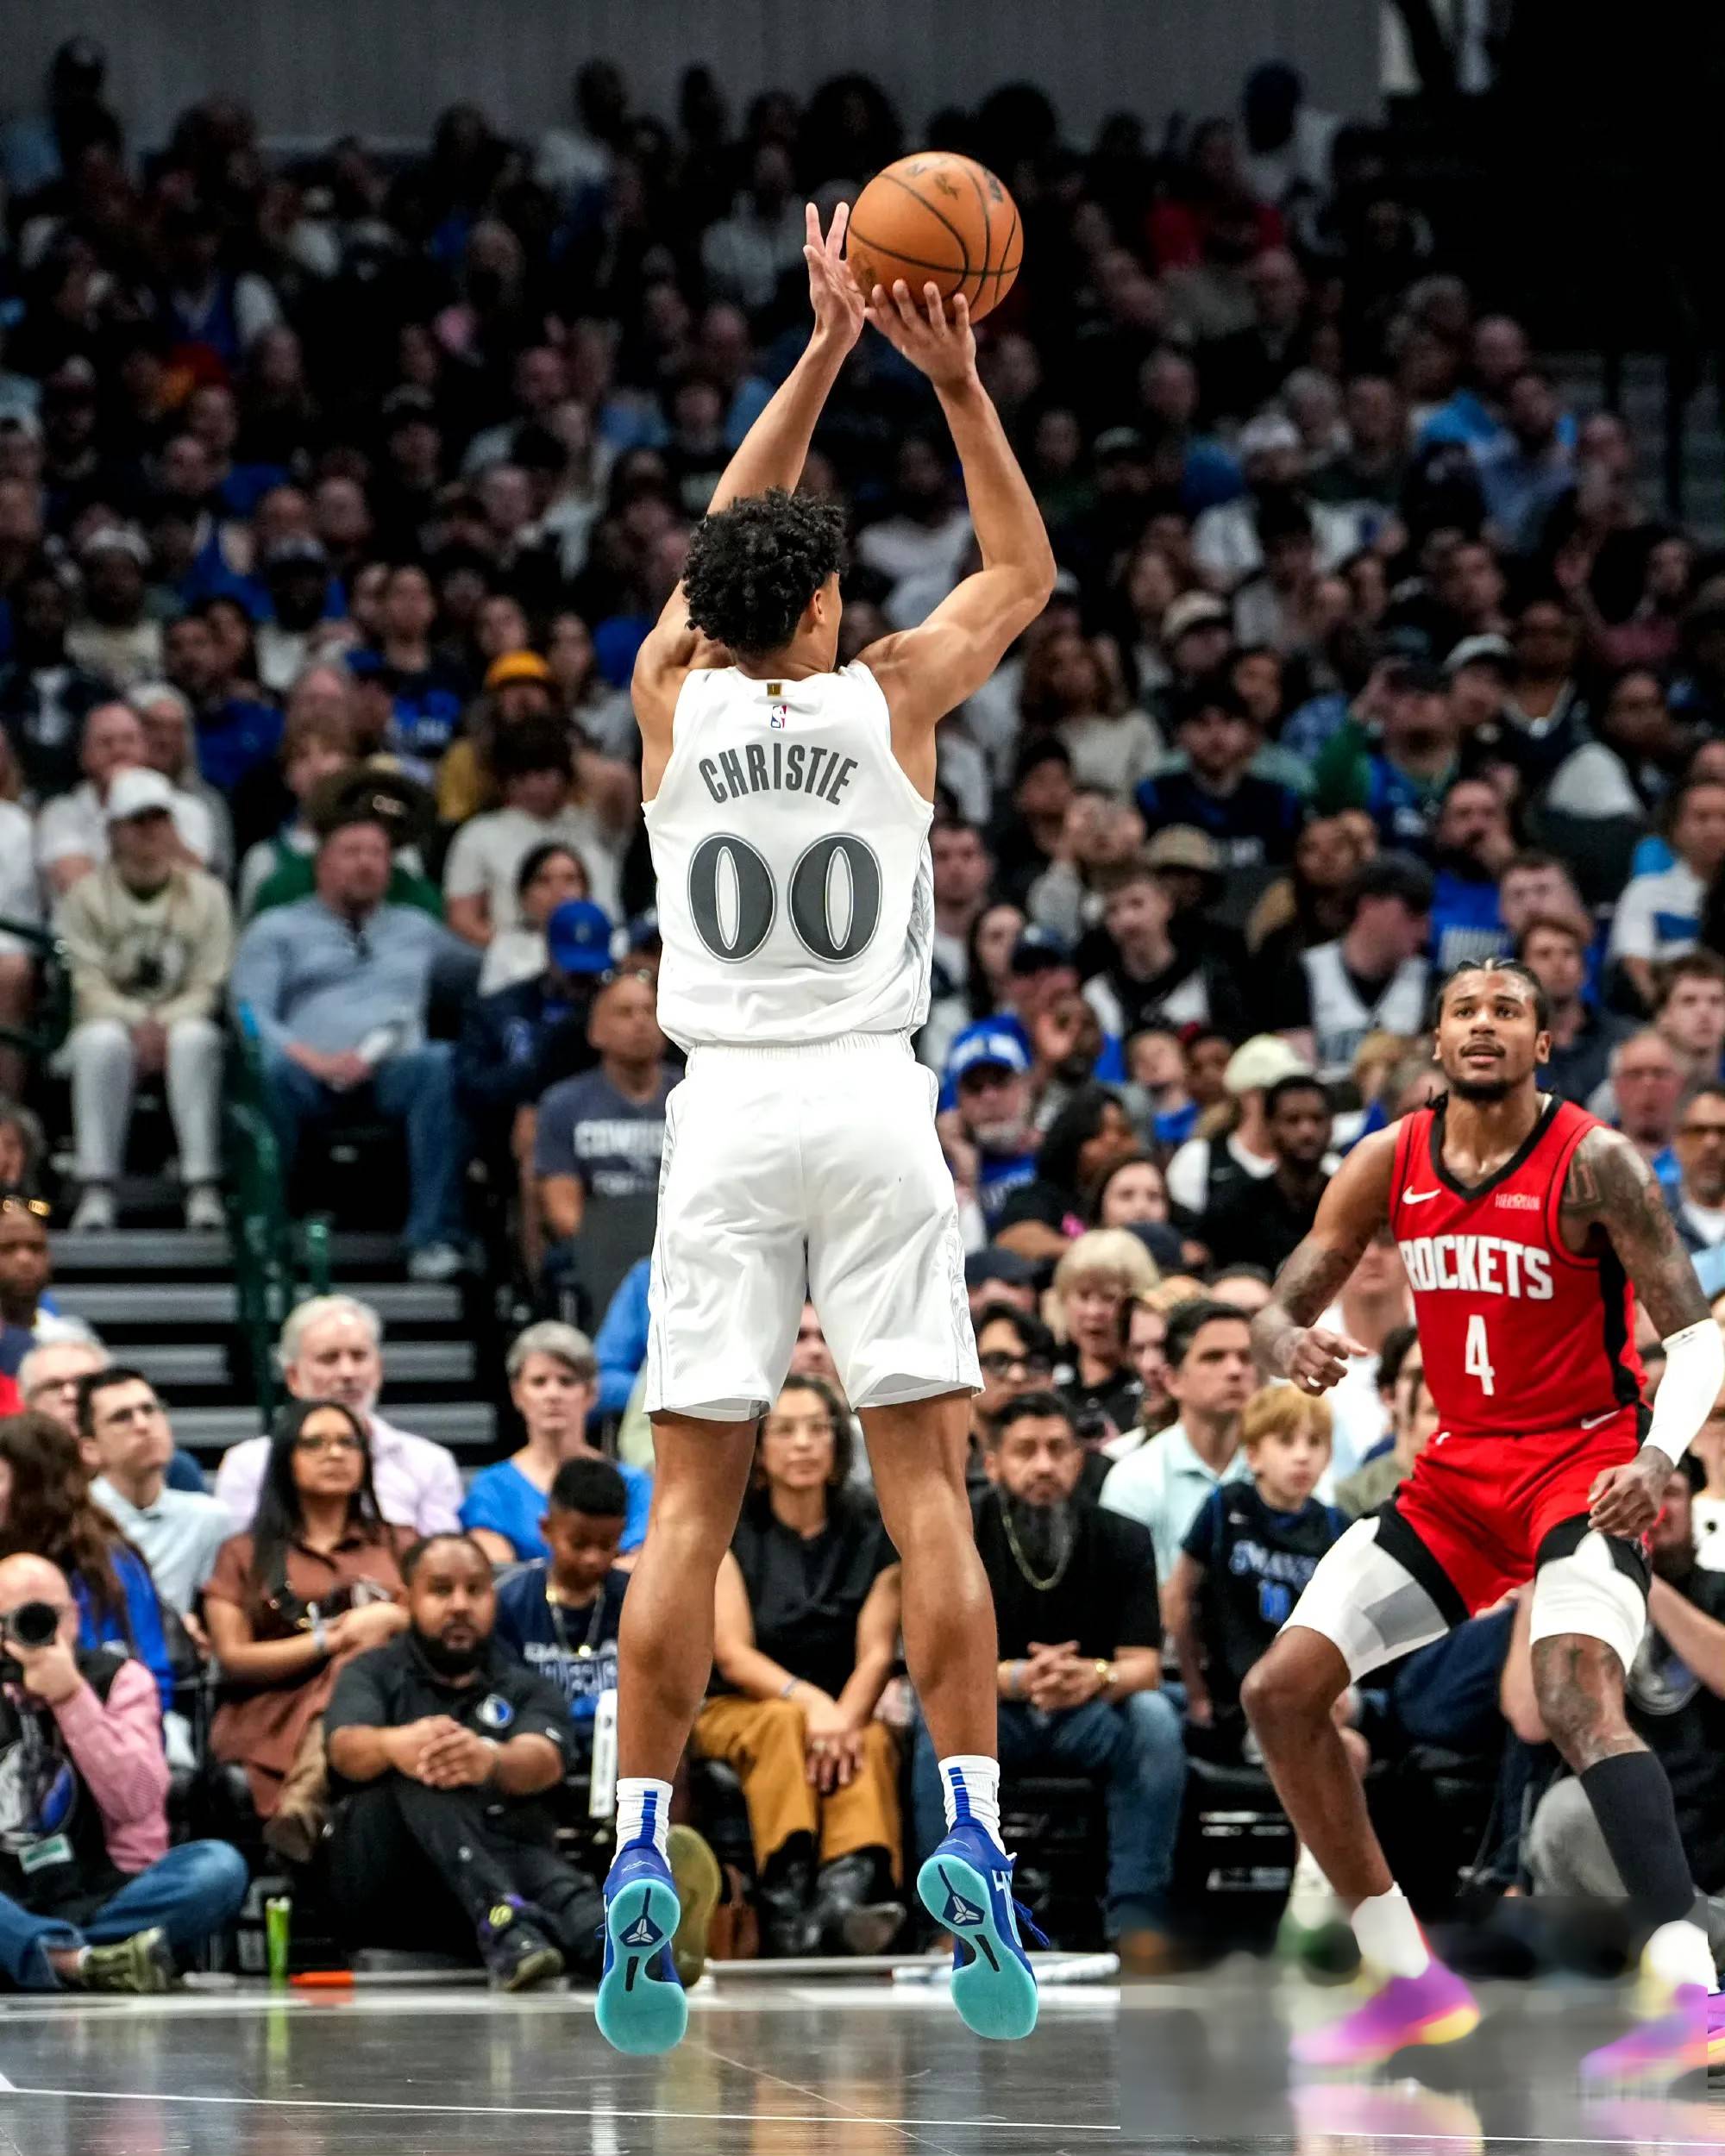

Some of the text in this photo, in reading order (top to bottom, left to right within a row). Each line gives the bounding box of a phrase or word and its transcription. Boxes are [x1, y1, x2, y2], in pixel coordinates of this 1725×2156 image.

[699, 743, 858, 805] CHRISTIE
[687, 831, 882, 965] 00
[1398, 1234, 1553, 1300] ROCKETS
[1465, 1314, 1495, 1396] 4
